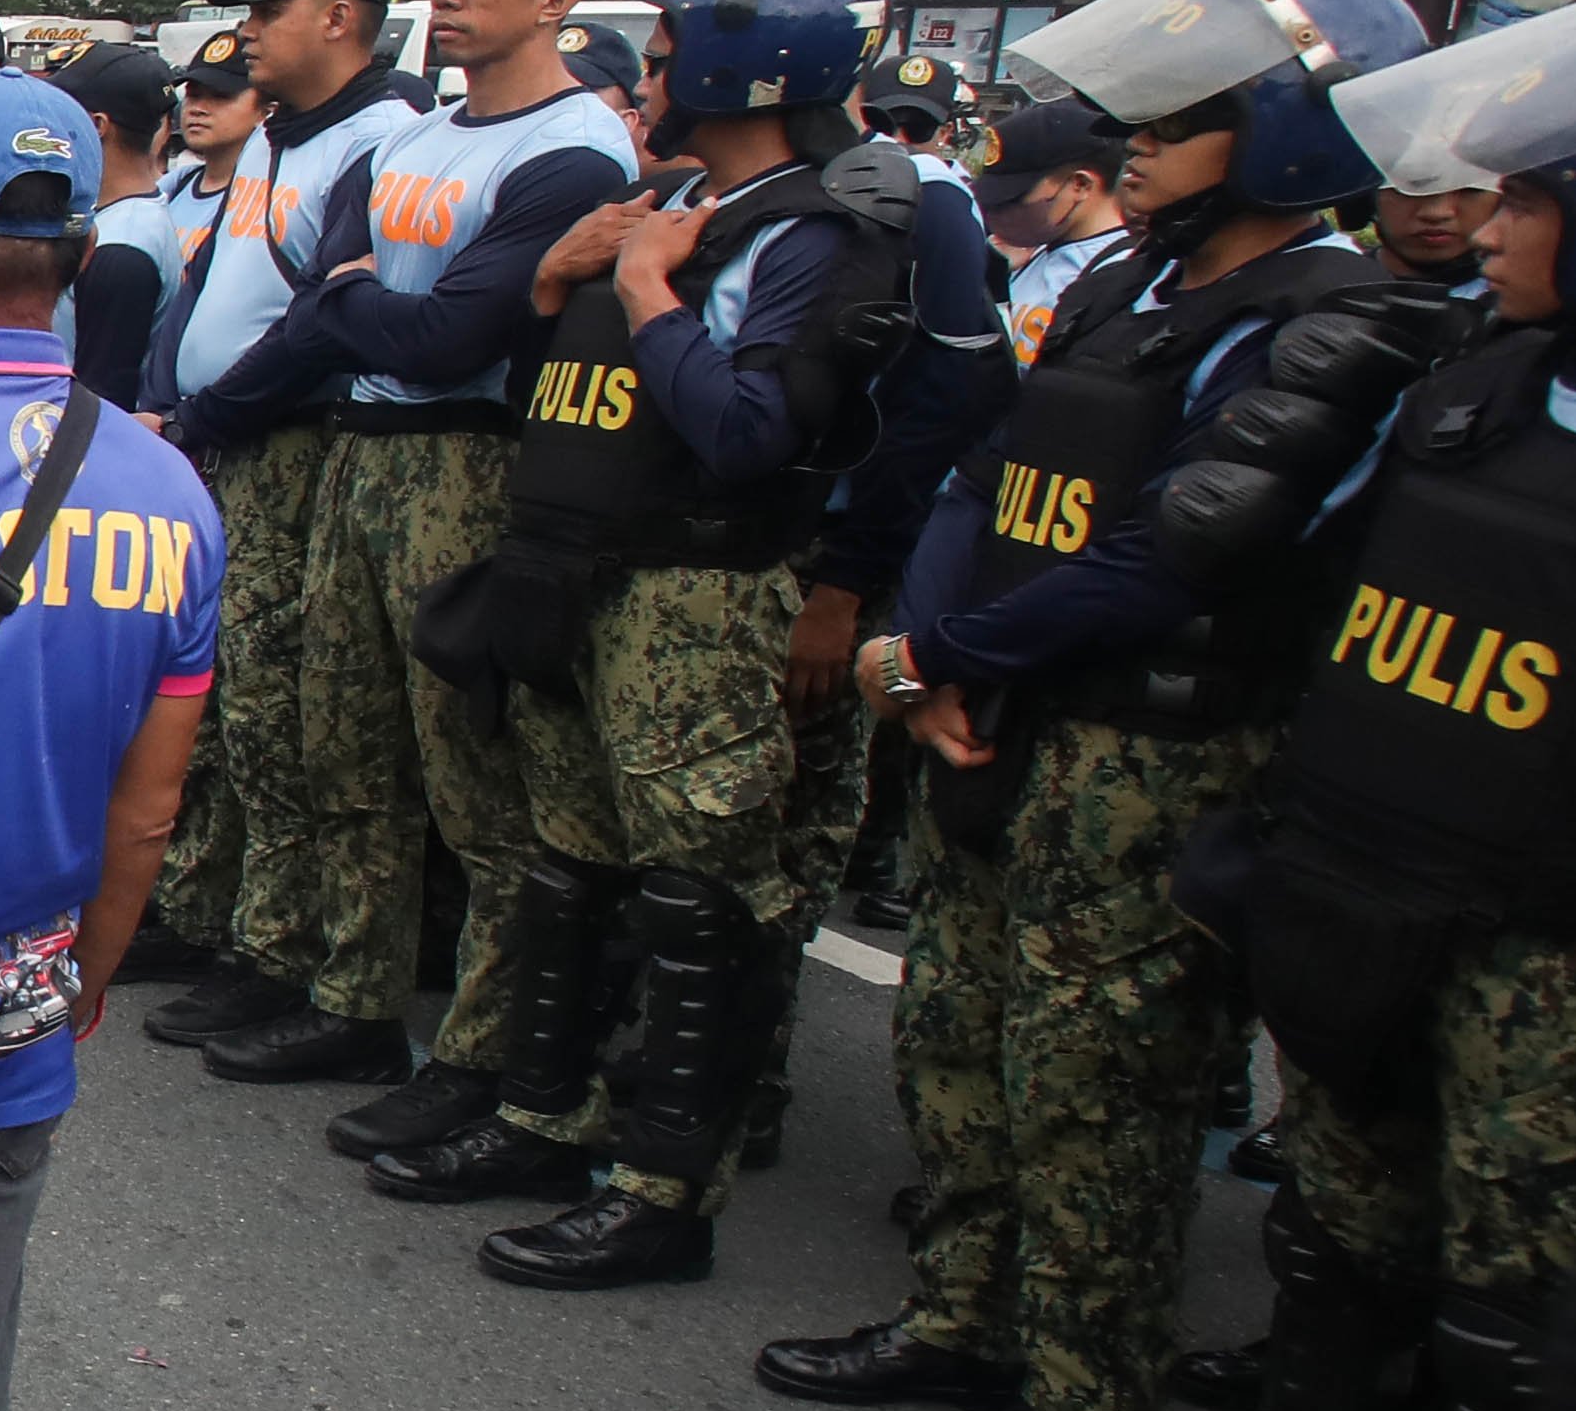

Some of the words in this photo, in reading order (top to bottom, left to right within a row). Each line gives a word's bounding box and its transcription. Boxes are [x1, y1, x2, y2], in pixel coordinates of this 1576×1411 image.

[370, 169, 467, 248] PULIS
[527, 361, 641, 431] PULIS
[1330, 583, 1562, 732] PULIS
